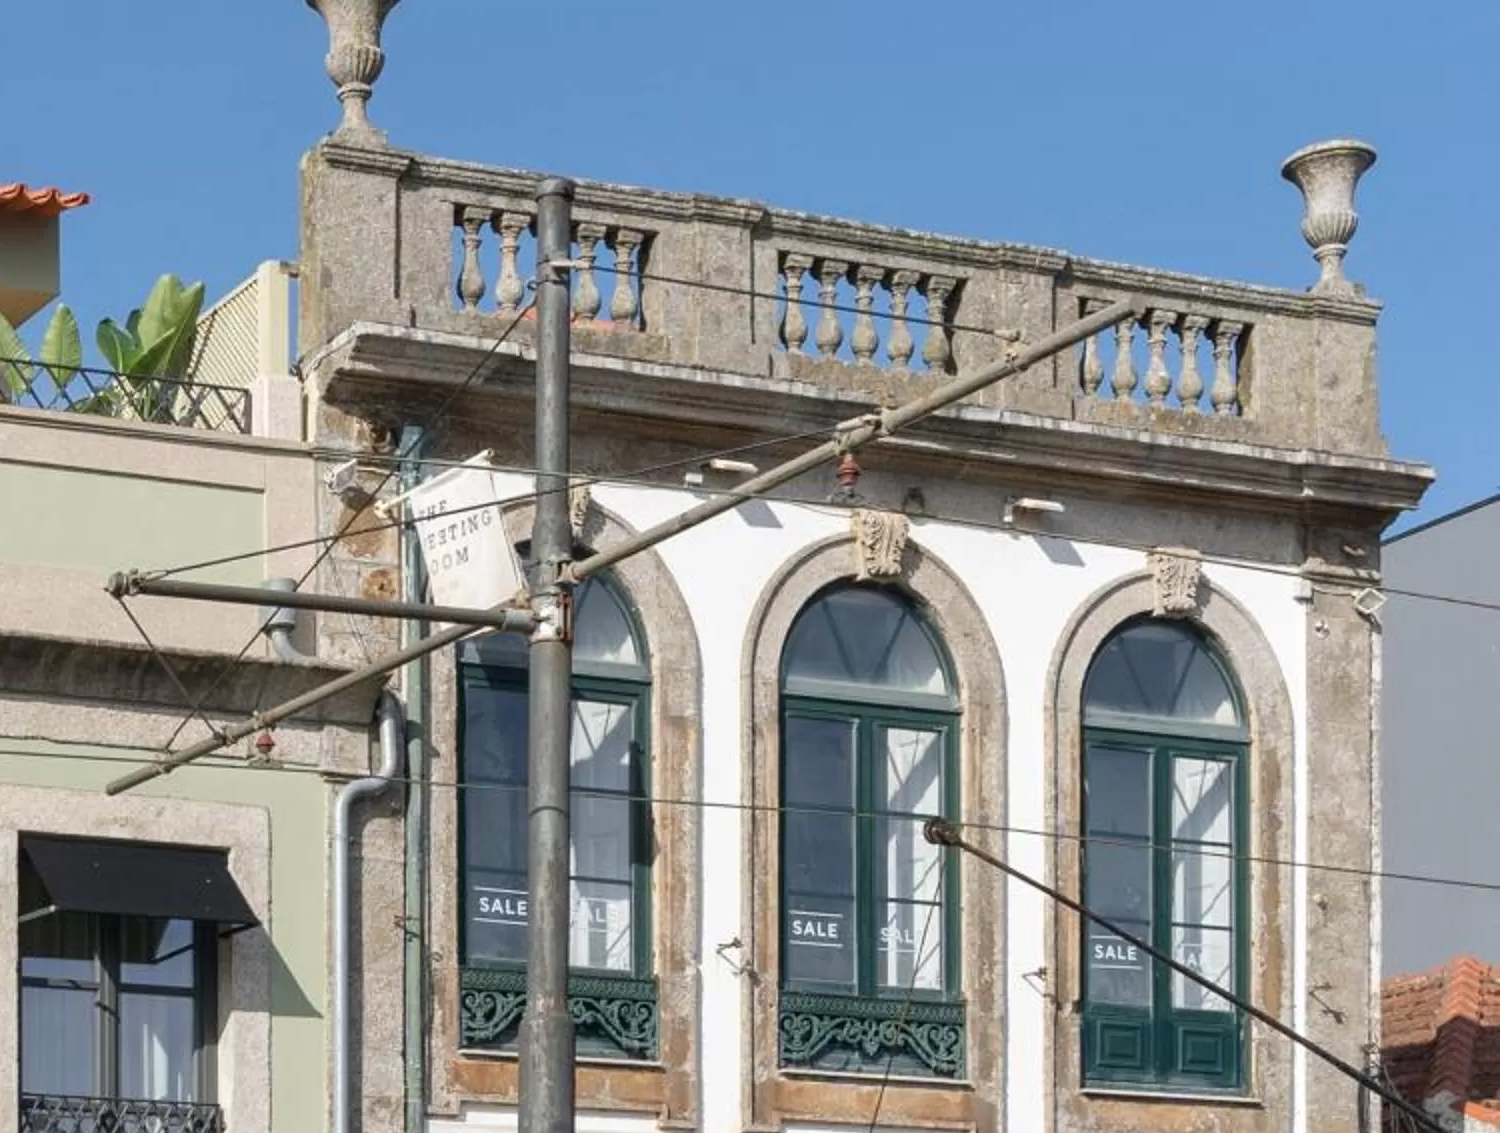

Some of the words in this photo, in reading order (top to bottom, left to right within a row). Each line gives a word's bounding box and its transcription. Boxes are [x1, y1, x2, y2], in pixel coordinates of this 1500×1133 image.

[429, 545, 469, 577] OOM
[479, 897, 528, 917] SALE
[792, 919, 838, 939] SALE
[879, 926, 920, 945] SAL
[1094, 944, 1138, 962] SALE
